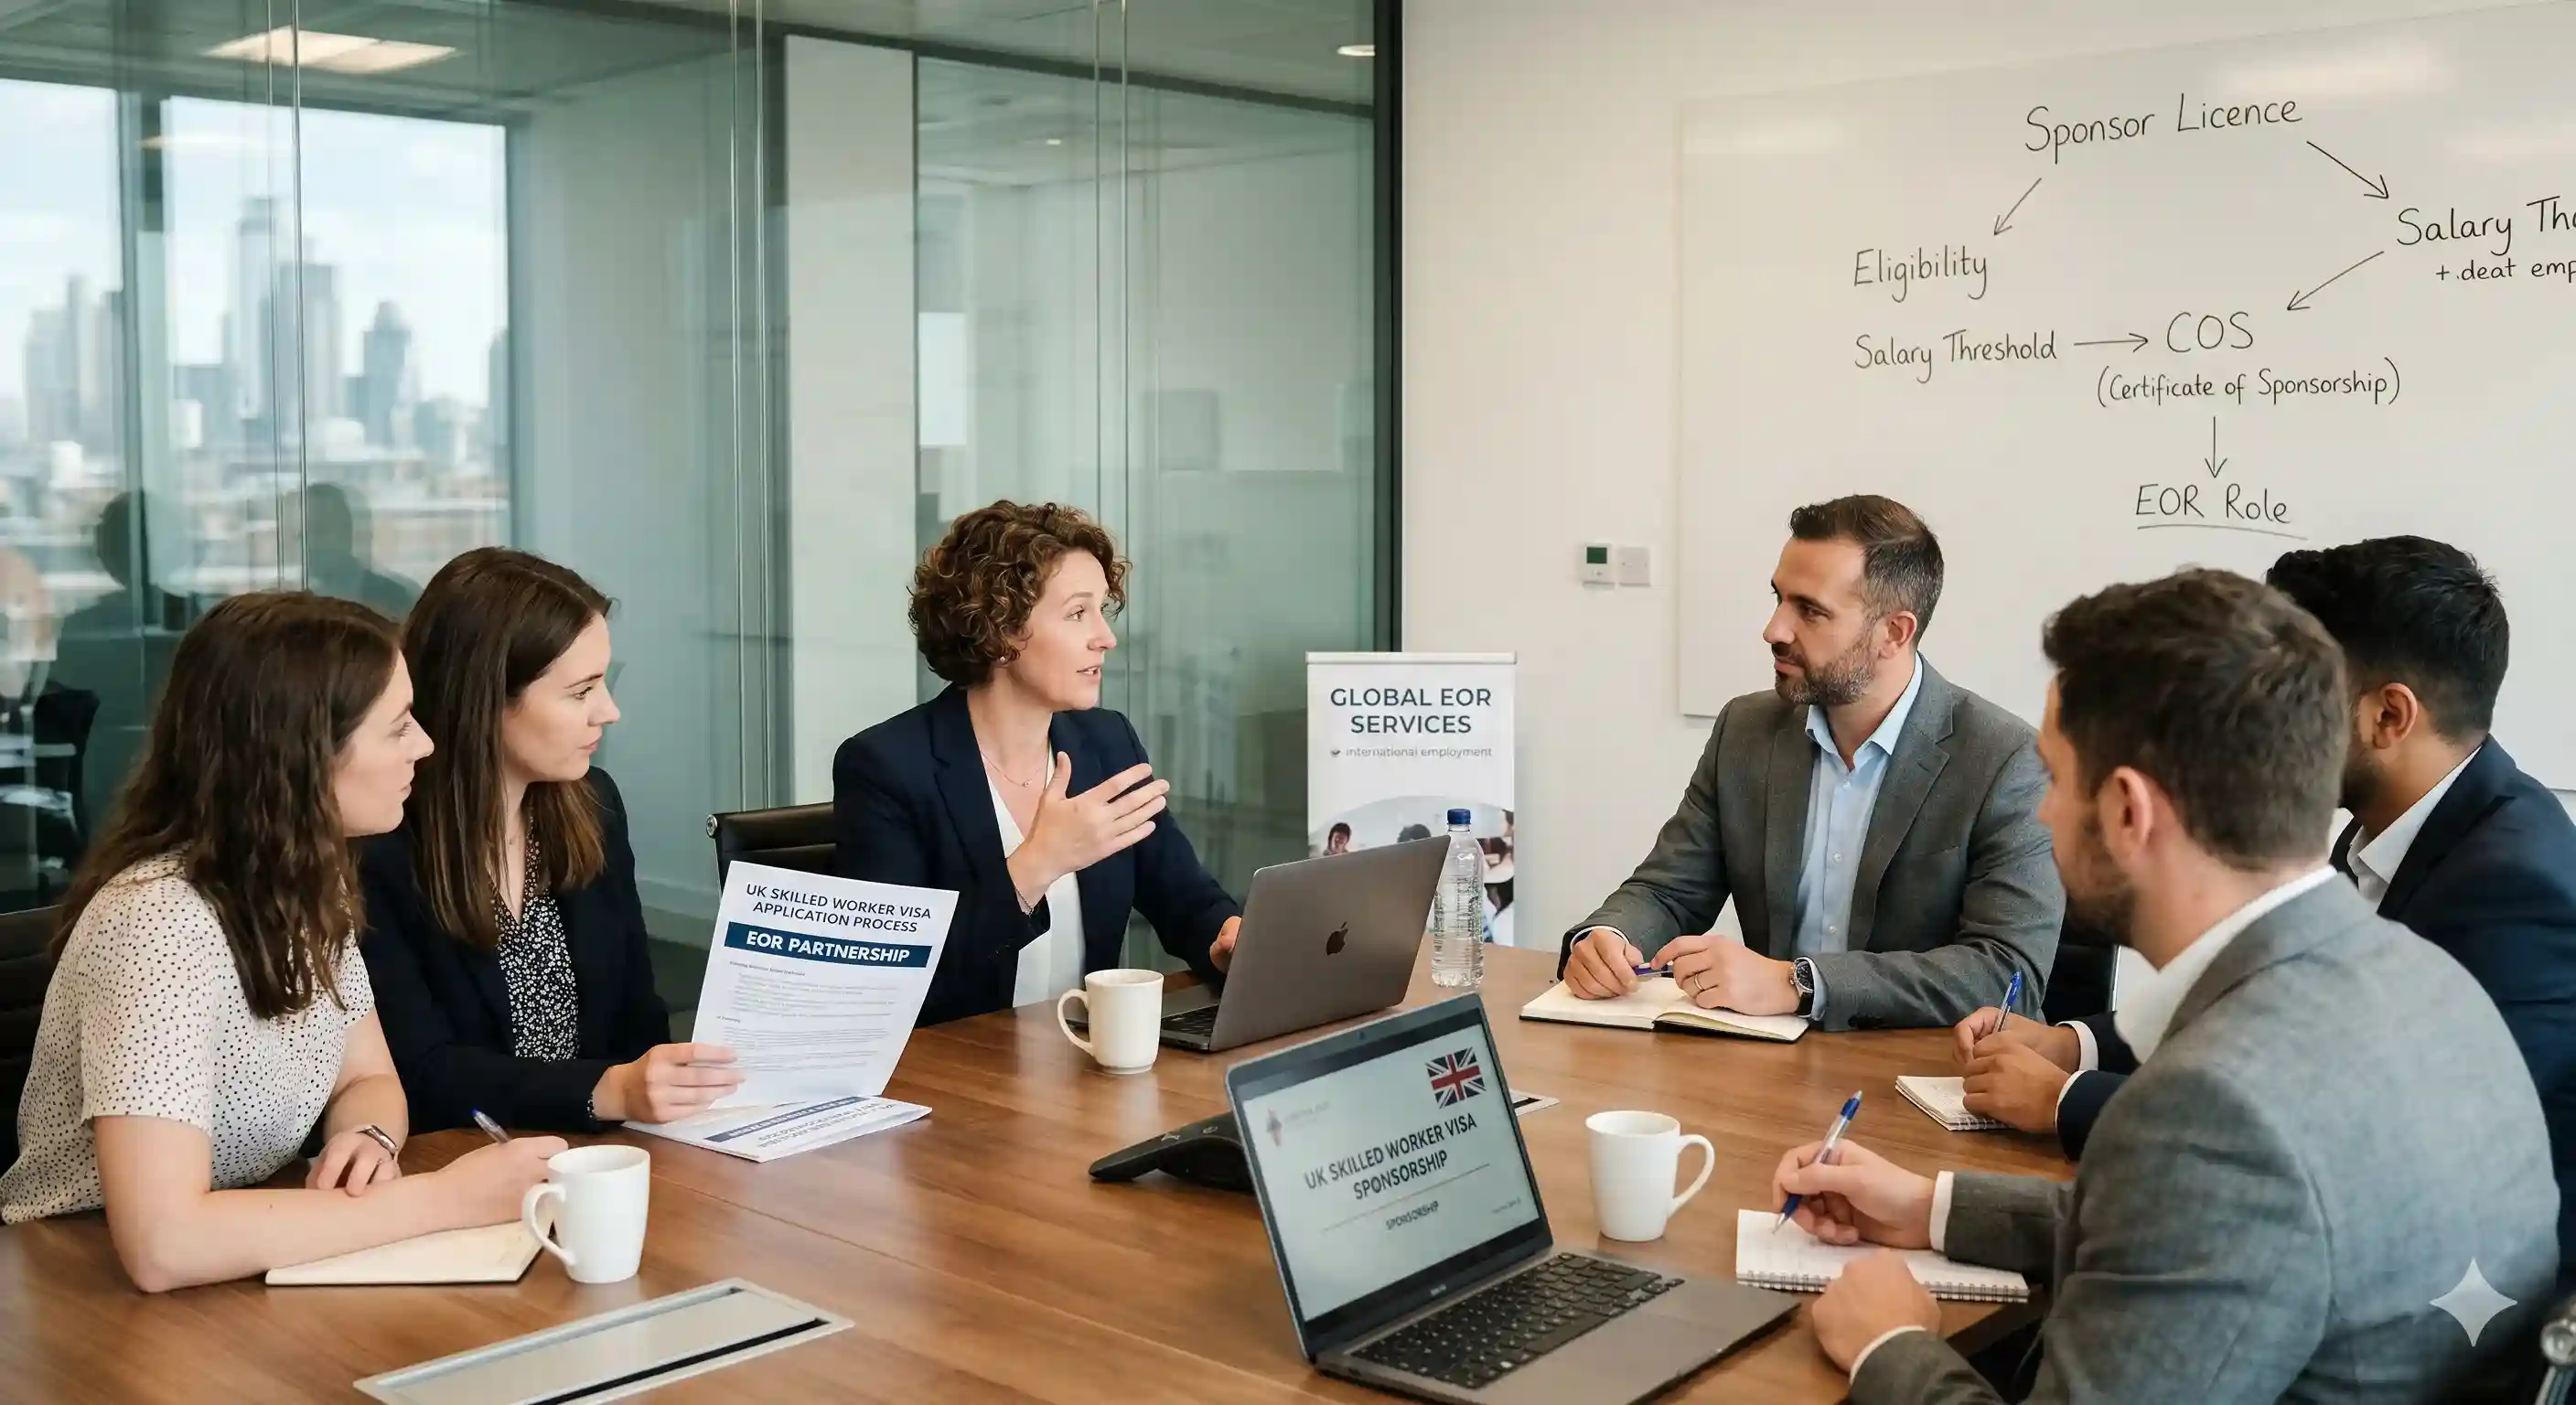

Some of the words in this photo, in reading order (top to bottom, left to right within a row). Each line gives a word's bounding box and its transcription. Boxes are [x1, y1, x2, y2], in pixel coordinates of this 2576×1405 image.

[2024, 105, 2156, 166] Sponsor
[2176, 92, 2303, 133] Licence
[2396, 207, 2512, 257] Salary
[2526, 195, 2576, 233] Th
[1853, 244, 1989, 304] Eligibility
[2166, 310, 2254, 353] COS
[1854, 333, 1933, 385] Salary
[1941, 327, 2058, 363] Threshold
[2097, 365, 2216, 408] (Certificate
[2224, 373, 2247, 405] of
[2258, 356, 2402, 406] Sponsorship)
[2135, 483, 2206, 519] EOR
[2225, 483, 2292, 525] Role
[1330, 687, 1433, 707] GLOBAL
[1440, 687, 1492, 707] EOR
[1350, 714, 1472, 735] SERVICES
[1346, 746, 1418, 757] international
[1421, 746, 1493, 758] employment
[746, 884, 767, 898] UK
[770, 888, 828, 907] SKILLED
[832, 897, 896, 916] WORKER
[900, 906, 931, 919] VISA
[753, 901, 850, 927] APPLICATION
[853, 917, 918, 933] PROCESS
[746, 930, 784, 950] EOR
[788, 938, 910, 962] PARTNERSHIP
[1304, 1167, 1327, 1189] UK
[1328, 1147, 1385, 1181] SKILLED
[1385, 1124, 1444, 1159] WORKER
[1444, 1112, 1477, 1136] VISA
[1353, 1150, 1448, 1200] SPONSORSHIP
